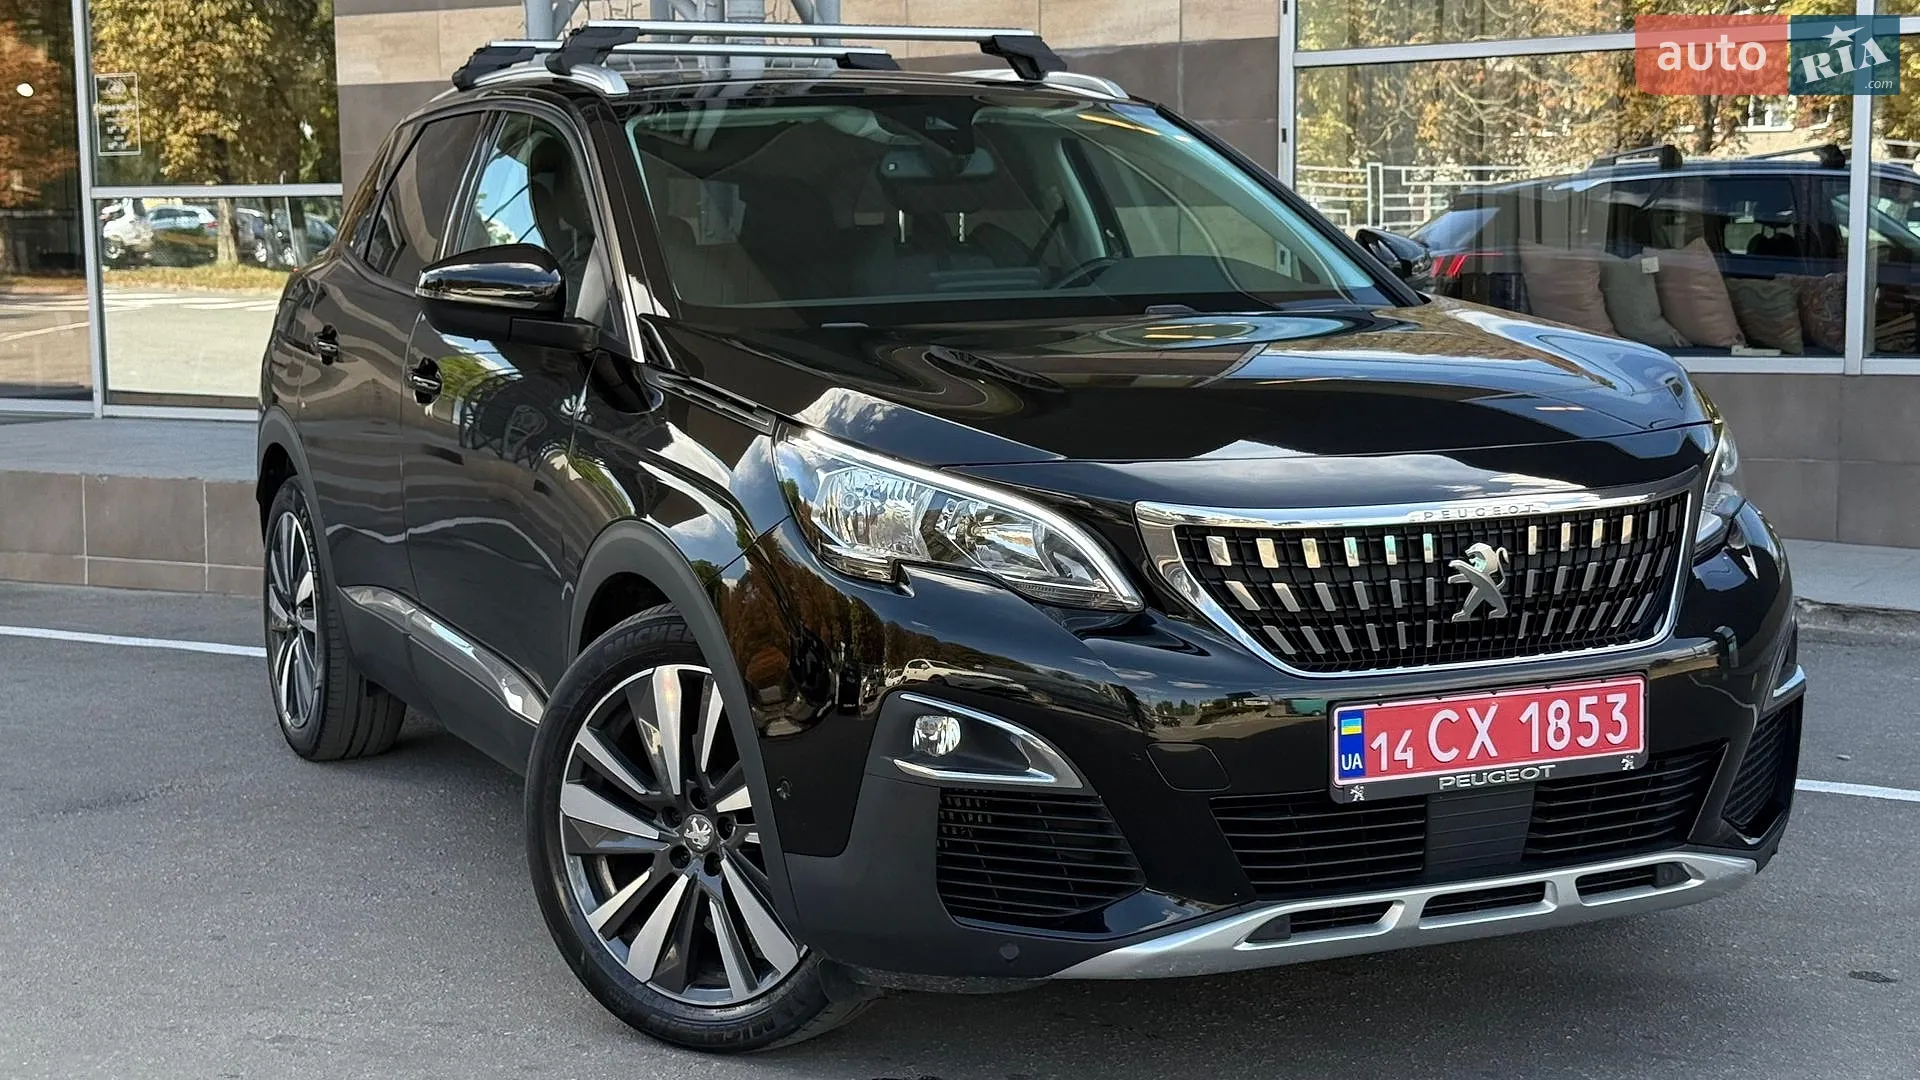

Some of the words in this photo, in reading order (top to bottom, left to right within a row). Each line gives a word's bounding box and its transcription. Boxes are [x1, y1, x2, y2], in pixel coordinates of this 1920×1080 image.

[1423, 504, 1535, 521] PEUGEOT
[1370, 728, 1414, 773] 14
[1427, 703, 1499, 762] CX
[1519, 692, 1628, 753] 1853
[1341, 752, 1364, 772] UA
[1439, 764, 1556, 790] PEUGEOT
